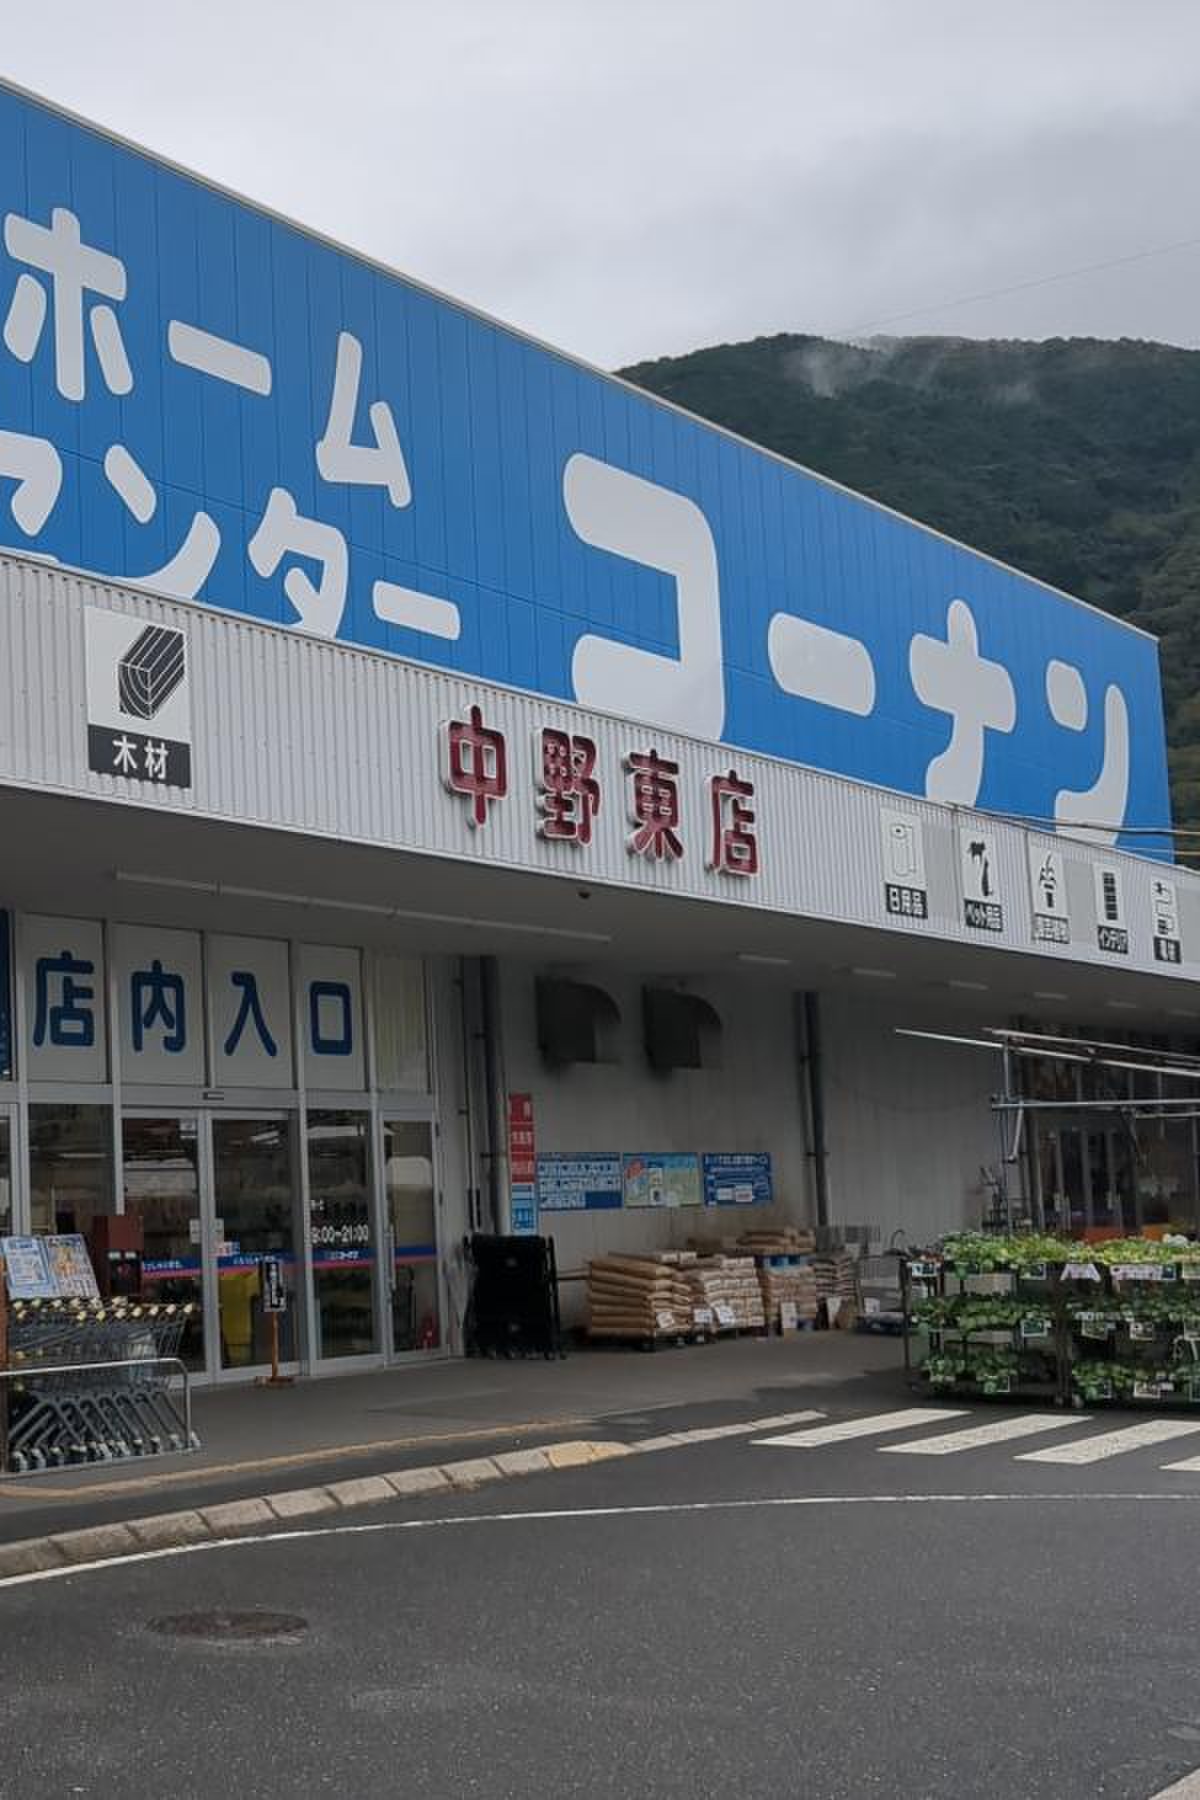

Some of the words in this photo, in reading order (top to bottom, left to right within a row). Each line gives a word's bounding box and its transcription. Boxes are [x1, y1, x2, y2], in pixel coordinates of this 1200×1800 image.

[3, 207, 411, 508] ホーム
[562, 452, 1130, 847] コーナン
[112, 735, 170, 780] 木材
[442, 705, 760, 877] 中野東店
[888, 886, 924, 916] 日用品
[32, 950, 353, 1058] 店内入口
